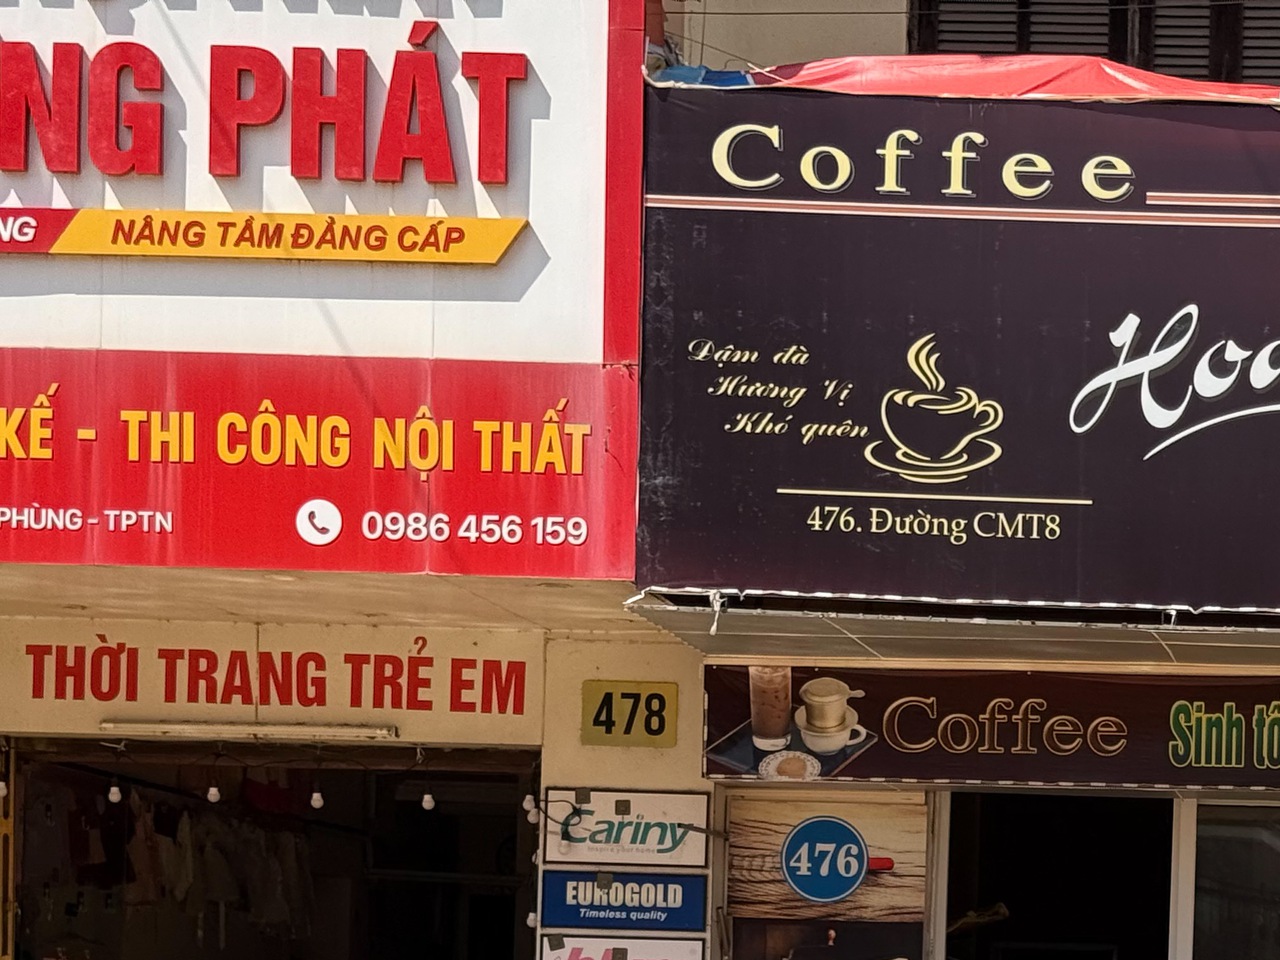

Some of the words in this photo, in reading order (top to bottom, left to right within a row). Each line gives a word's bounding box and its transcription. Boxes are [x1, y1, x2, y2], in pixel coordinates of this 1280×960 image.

[208, 20, 529, 185] PHÁT
[711, 123, 1136, 202] Coffee
[111, 217, 206, 248] NÂNG
[397, 222, 467, 253] CẤP
[772, 344, 811, 366] đà
[707, 374, 808, 408] Hương
[822, 378, 854, 407] Vị
[0, 383, 59, 462] KẾ
[120, 410, 196, 464] THI
[217, 399, 351, 469] CÔNG
[373, 405, 455, 482] NỘI
[473, 398, 593, 477] THẤT
[723, 411, 794, 435] Khó
[800, 418, 870, 445] quên
[0, 503, 83, 532] PHÙNG
[104, 510, 173, 534] TPTN
[361, 511, 451, 544] 0986
[458, 513, 523, 545] 456
[531, 515, 589, 546] 159
[806, 505, 863, 534] 476.
[869, 507, 968, 545] Đường
[973, 512, 1061, 541] CMT8
[24, 634, 140, 702] THỜI
[157, 647, 328, 709] TRANG
[344, 636, 436, 713] TRẺ
[450, 656, 528, 717] EM
[591, 690, 668, 739] 478
[882, 695, 1129, 757] Coffee
[1167, 698, 1246, 769] Sinh
[560, 808, 694, 854] Cariny
[788, 841, 860, 878] 476
[565, 880, 684, 909] EUROGOLD
[580, 908, 627, 920] Timeless
[630, 909, 668, 921] quality
